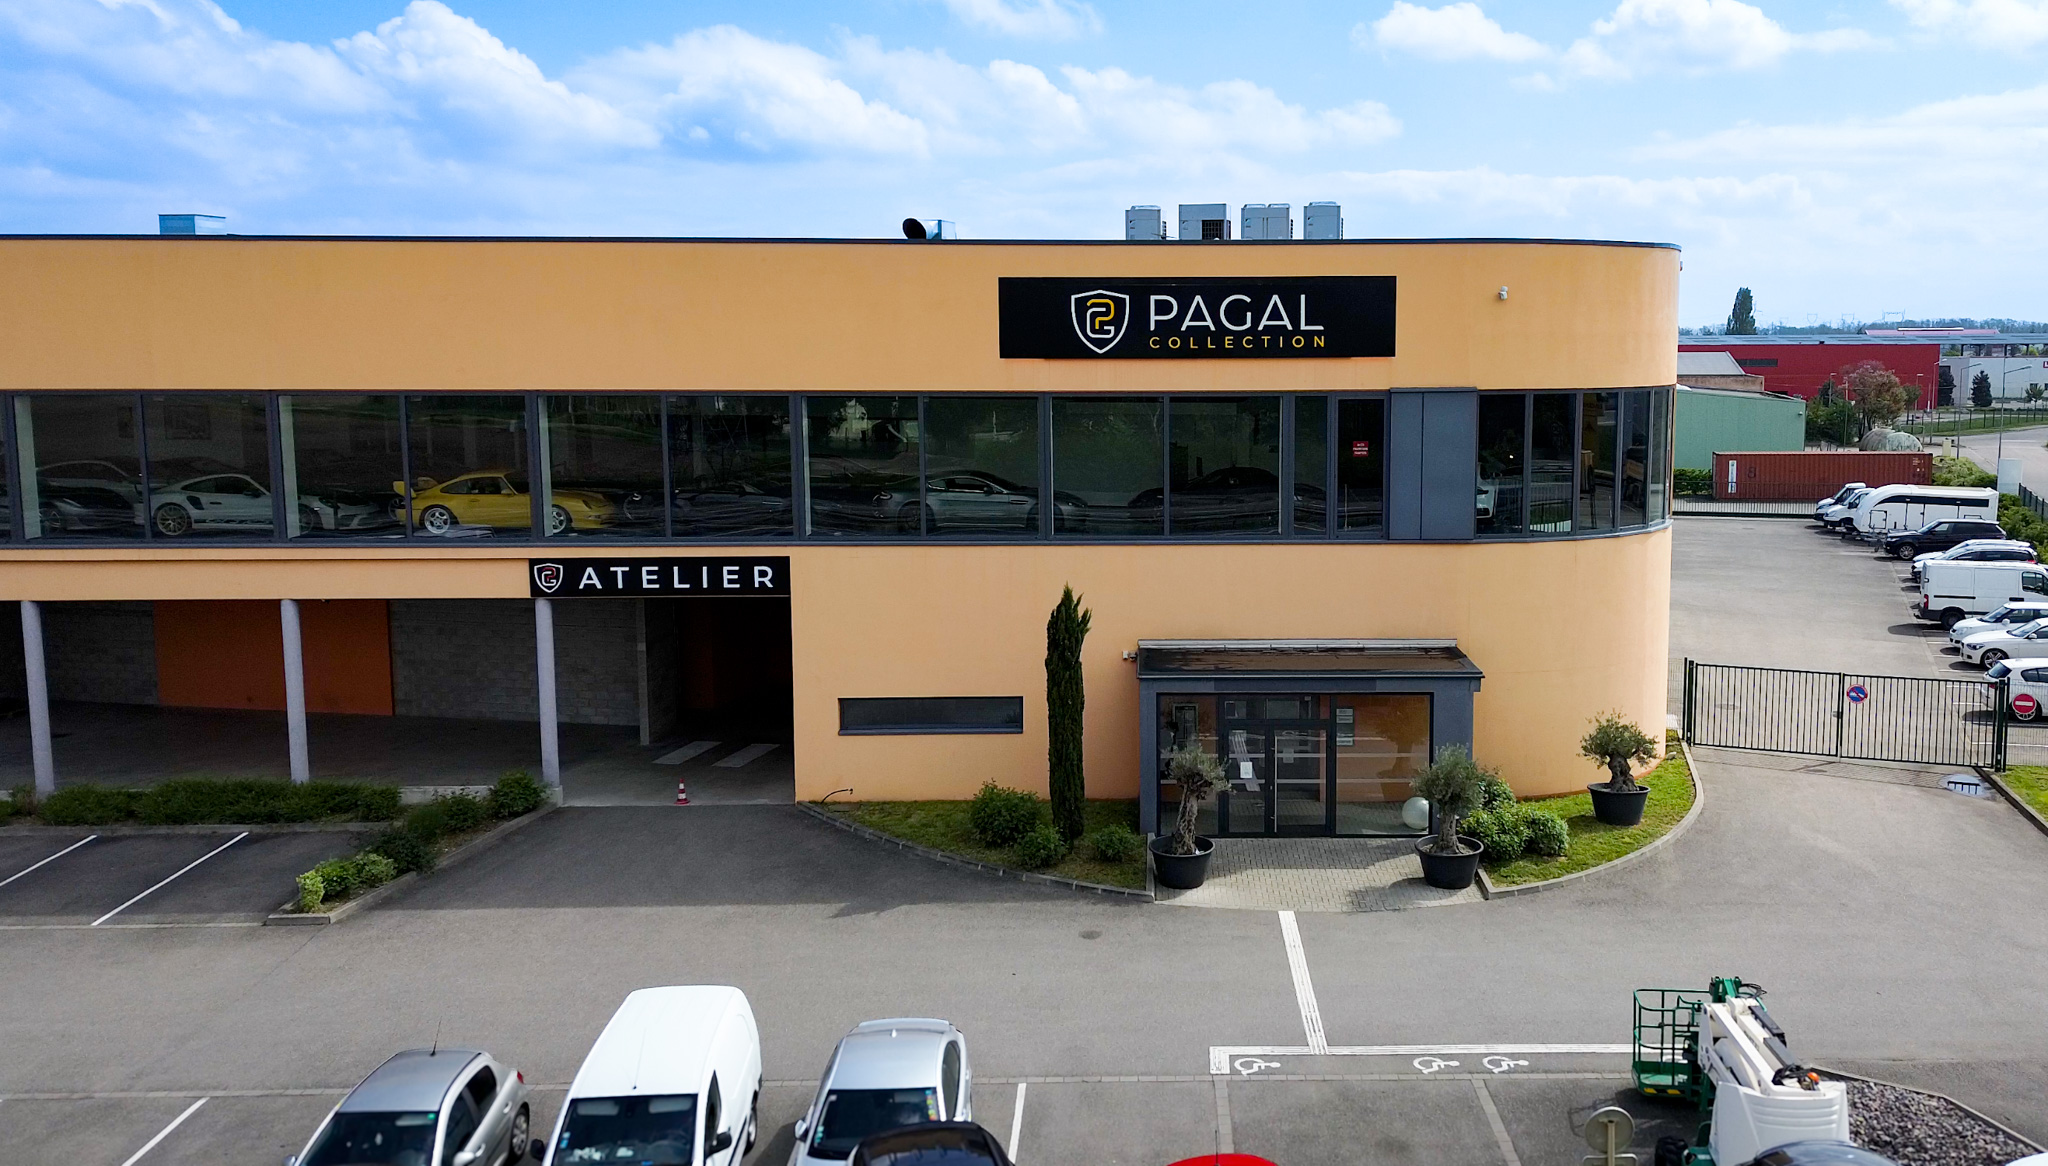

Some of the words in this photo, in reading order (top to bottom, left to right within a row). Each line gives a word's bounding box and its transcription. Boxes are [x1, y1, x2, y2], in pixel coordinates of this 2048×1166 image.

[1150, 294, 1324, 331] PAGAL
[1150, 336, 1324, 349] COLLECTION
[579, 566, 773, 589] ATELIER
